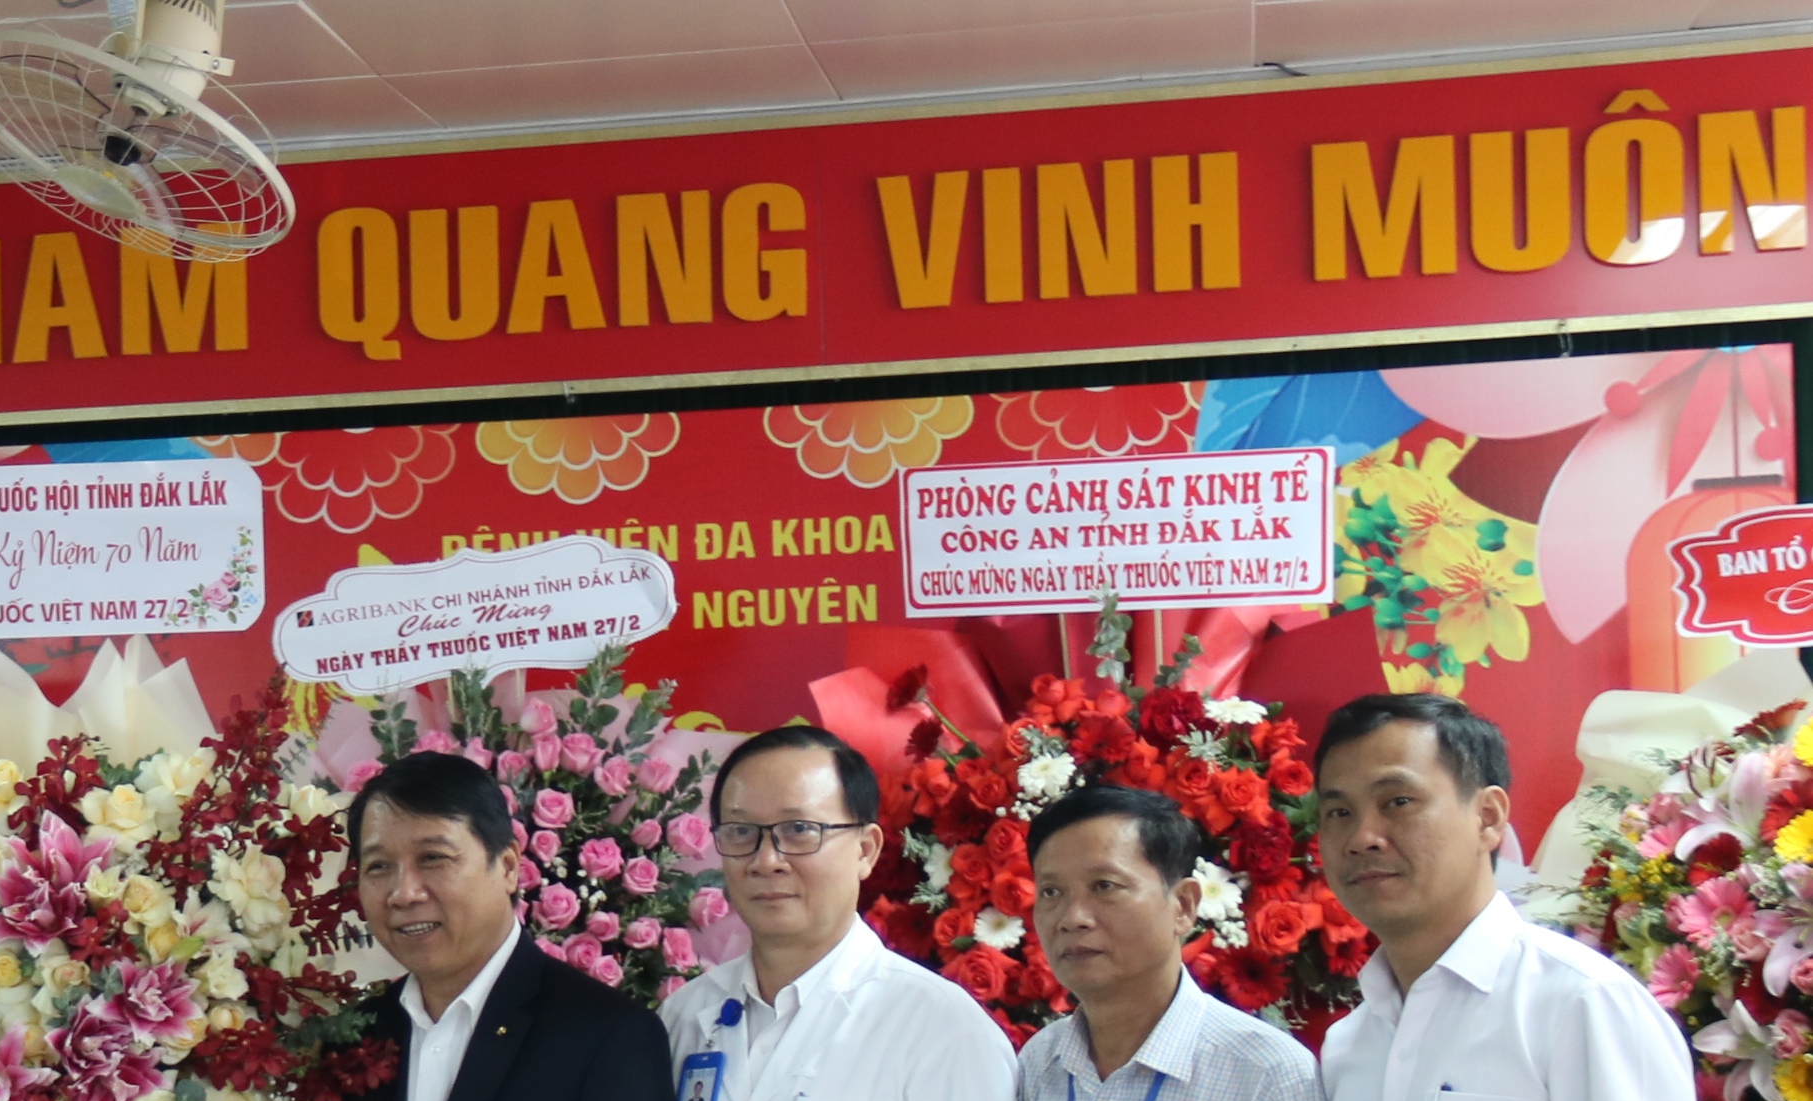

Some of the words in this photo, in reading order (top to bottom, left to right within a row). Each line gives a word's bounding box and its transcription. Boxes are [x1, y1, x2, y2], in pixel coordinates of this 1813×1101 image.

[316, 182, 807, 361] QUANG
[876, 151, 1242, 311] VINH
[1311, 88, 1808, 282] MUÔN
[45, 480, 79, 516] HỘI
[86, 475, 133, 509] TỈNH
[140, 472, 181, 508] ĐẮK
[188, 470, 227, 506] LẮK
[916, 476, 1017, 519] PHÒNG
[1025, 468, 1109, 514] CẢNH
[1117, 467, 1175, 510] SÁT
[1183, 472, 1262, 507] KINH
[1270, 454, 1310, 502] TẾ
[32, 530, 100, 569] Niệm
[105, 543, 132, 572] 70
[138, 526, 202, 562] Năm
[695, 520, 756, 561] ĐA
[771, 513, 895, 557] KHOA
[941, 524, 1019, 553] CÔNG
[1028, 526, 1069, 550] AN
[1078, 511, 1149, 547] TỈNH
[1158, 508, 1222, 544] ĐẮK
[1231, 505, 1293, 541] LẮK
[920, 563, 964, 597] CHÚC
[968, 562, 1017, 594] MỪNG
[1021, 559, 1068, 592] NGÀY
[1073, 552, 1118, 590] THẦY
[1123, 550, 1181, 588] THUỐC
[1185, 552, 1225, 593] VIỆT
[1230, 558, 1269, 585] NAM
[1274, 557, 1308, 588] 27/2
[1716, 549, 1769, 577] BAN
[1770, 535, 1807, 571] TỔ
[40, 598, 83, 624] VIỆT
[91, 600, 137, 620] NAM
[144, 597, 189, 619] 27/2
[318, 597, 428, 626] AGRIBANK
[432, 593, 462, 609] CHI
[467, 583, 530, 604] NHÁNH
[534, 576, 572, 595] TỈNH
[578, 567, 614, 590] ĐẮK
[619, 562, 652, 584] LẮK
[692, 577, 879, 630] NGUYÊN
[397, 614, 462, 638] Chúc
[472, 602, 553, 625] Mừng
[316, 651, 364, 674] NGÀY
[427, 631, 490, 658] THUỐC
[496, 627, 541, 650] VIỆT
[547, 622, 588, 642] NAM
[594, 615, 641, 636] 27/2
